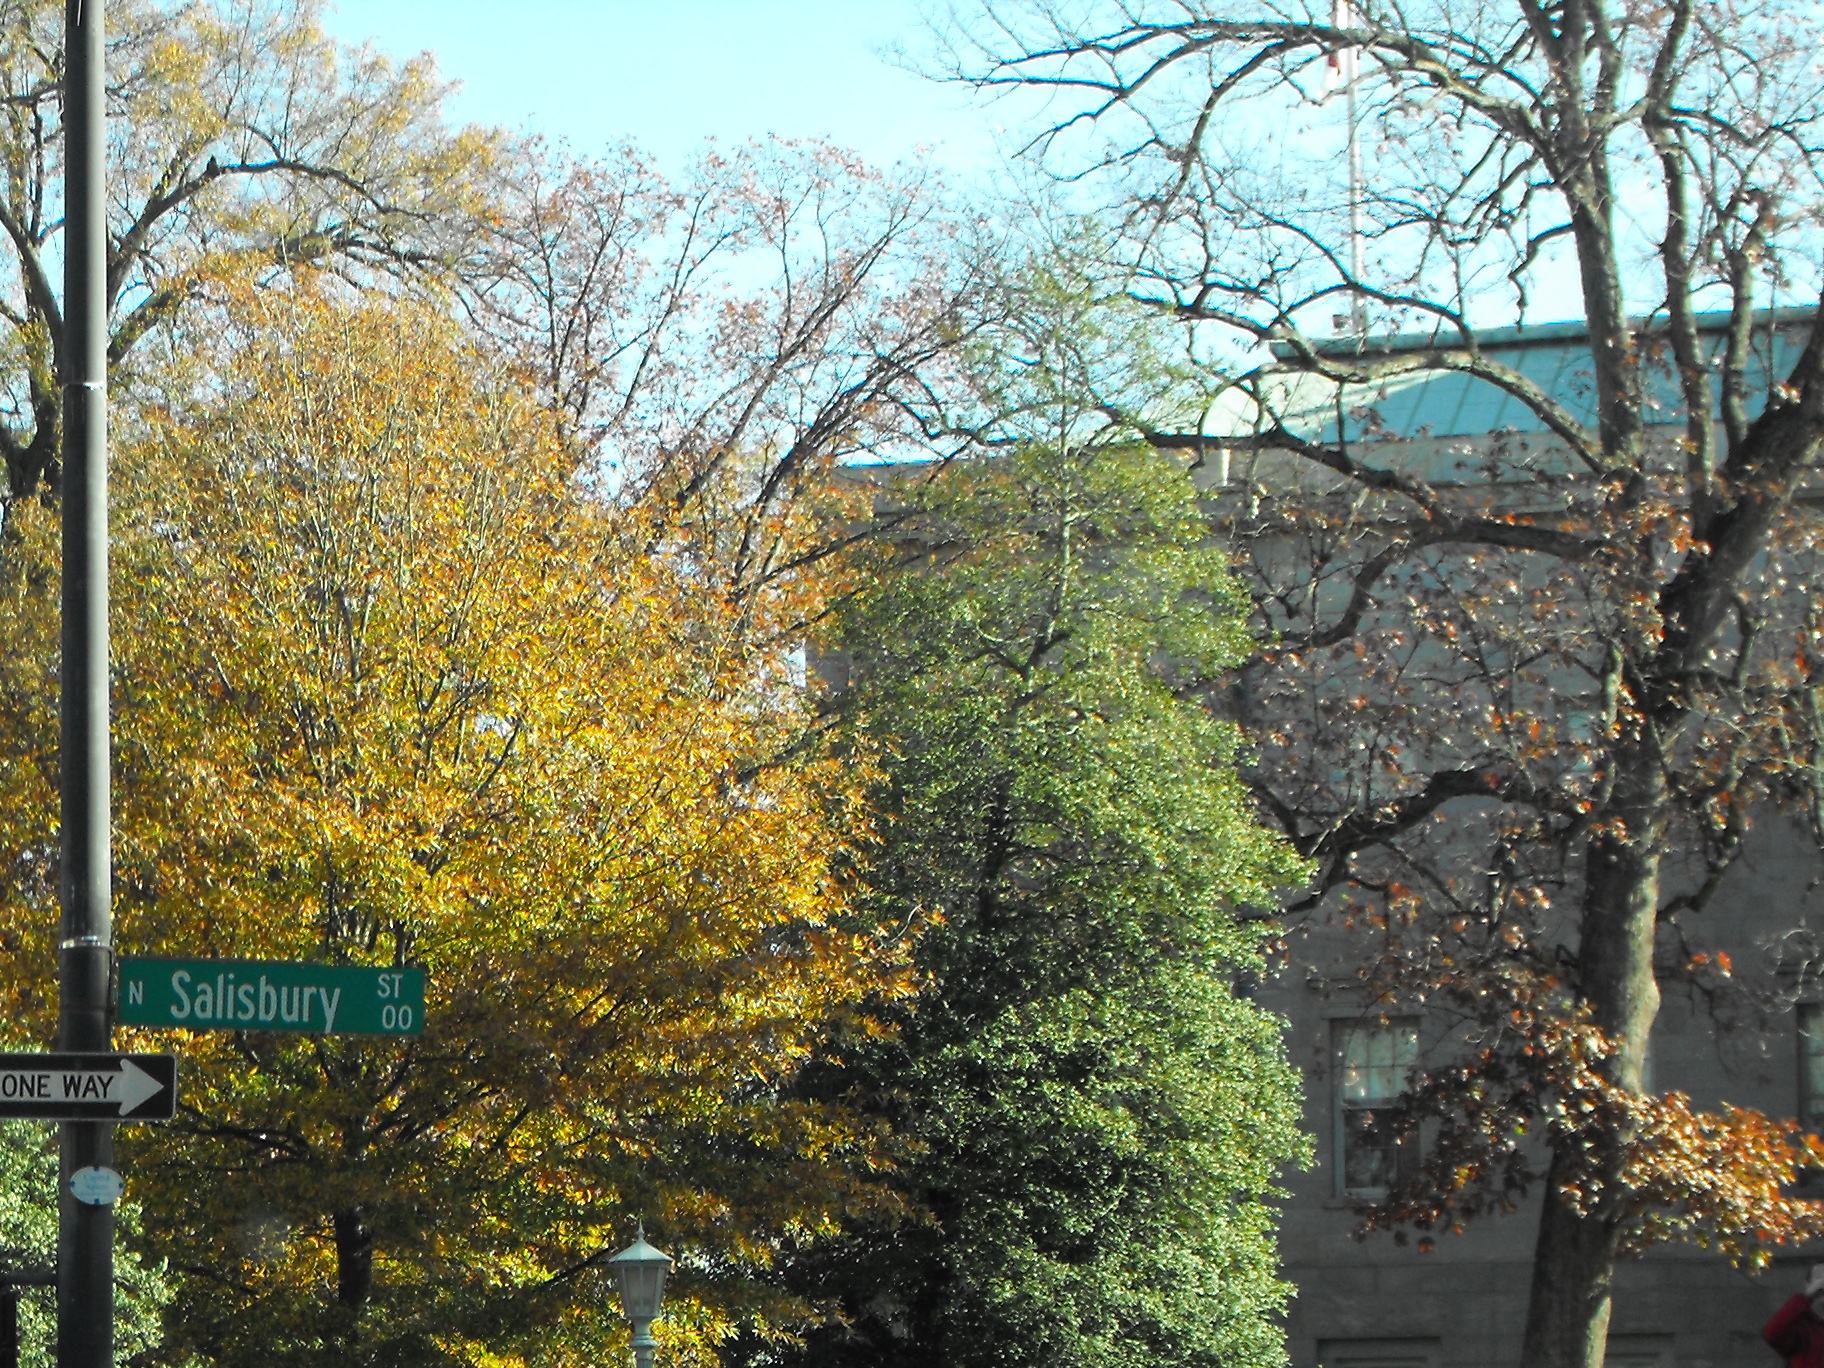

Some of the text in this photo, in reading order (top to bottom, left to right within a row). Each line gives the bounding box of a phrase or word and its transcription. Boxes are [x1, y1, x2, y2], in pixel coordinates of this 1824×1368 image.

[129, 969, 404, 1034] N Salisbury ST
[1, 1074, 114, 1099] ONE WAY
